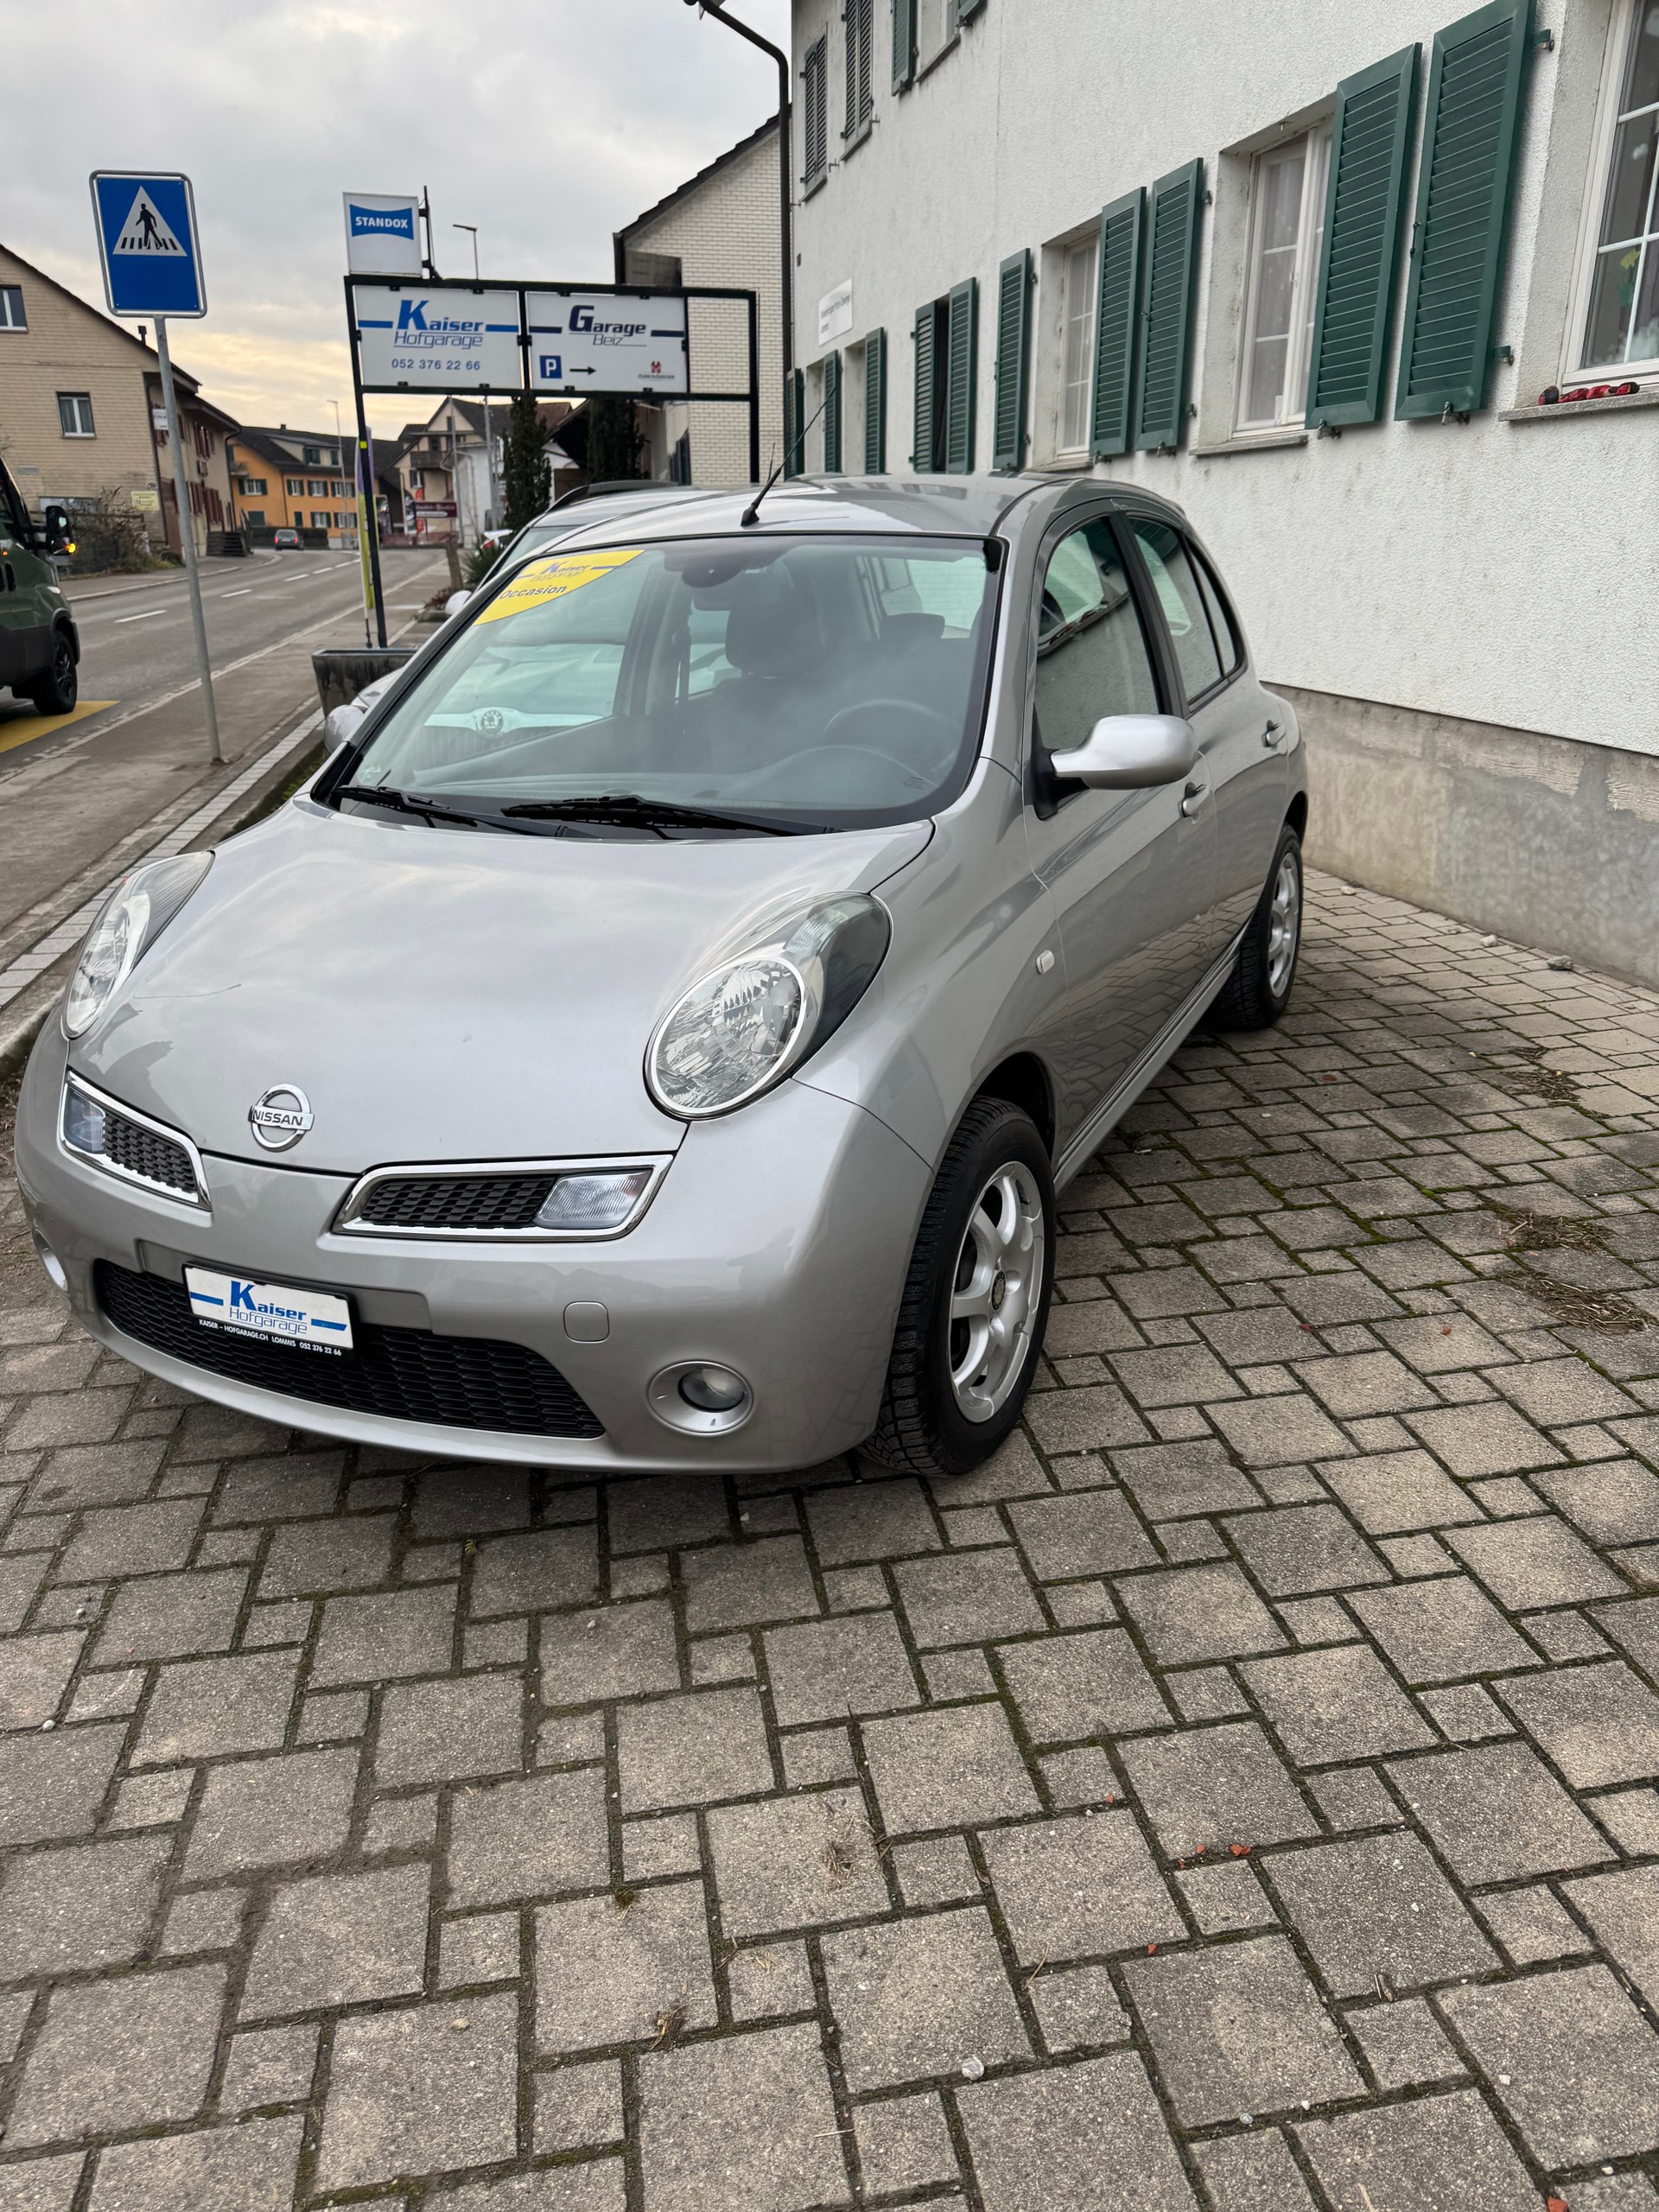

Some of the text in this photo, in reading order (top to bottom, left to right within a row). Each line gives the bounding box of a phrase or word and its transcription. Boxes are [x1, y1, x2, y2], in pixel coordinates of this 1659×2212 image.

[355, 216, 409, 229] STANDOX
[397, 299, 484, 332] Kaiser
[569, 305, 646, 337] Garage
[394, 330, 483, 350] Hofgarage
[593, 334, 624, 346] Beiz
[391, 359, 480, 371] 052 376 22 66
[545, 358, 557, 377] P
[499, 585, 568, 600] Occasion
[252, 1109, 303, 1127] NISSAN
[230, 1280, 307, 1321] Kaiser
[230, 1306, 308, 1335] Hofgarage
[199, 1319, 219, 1329] KAISER
[224, 1325, 270, 1341] HOFGARAGE.CH
[271, 1336, 296, 1347] LOMMIS
[299, 1342, 311, 1351] 052
